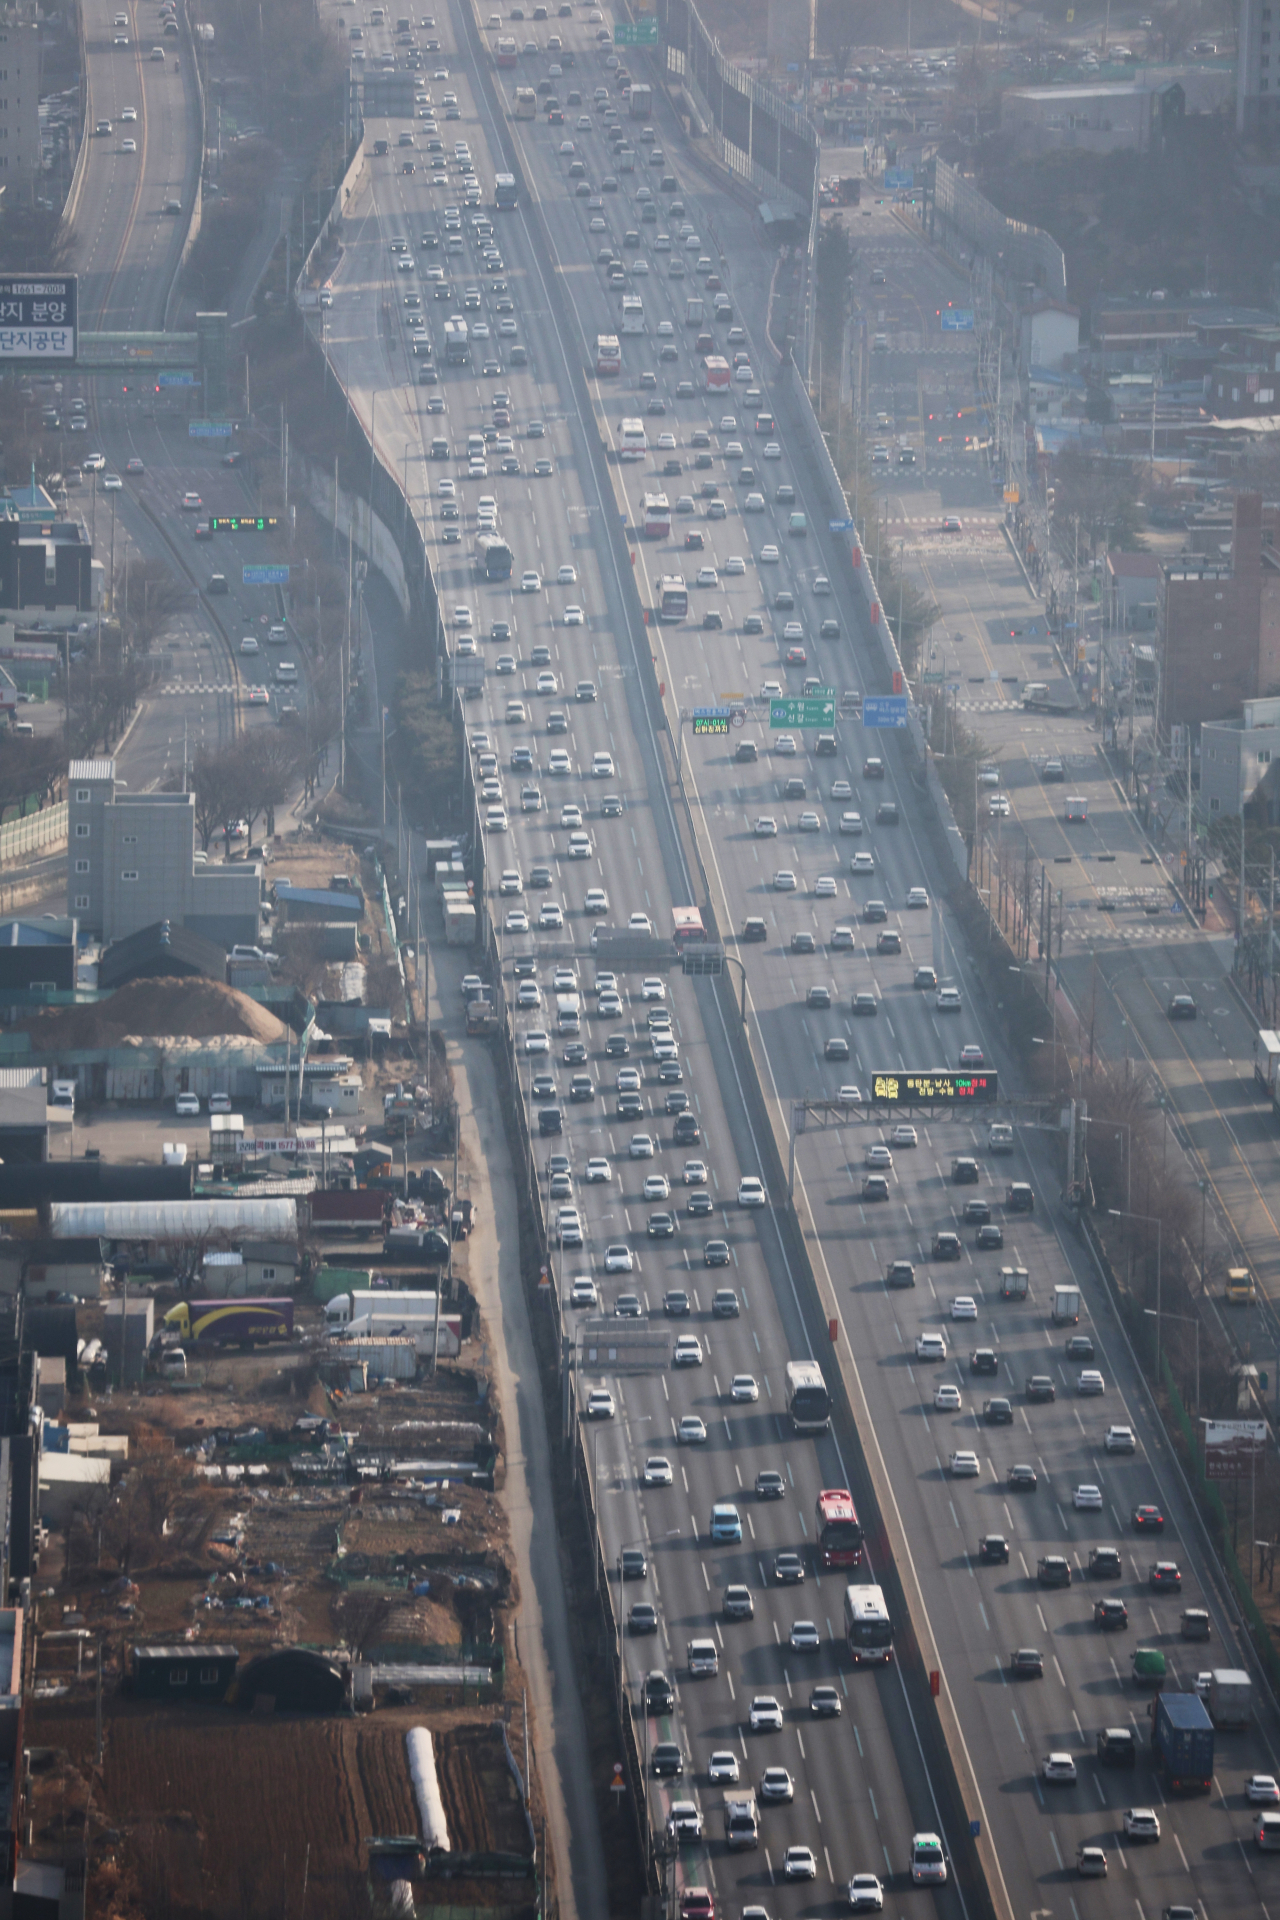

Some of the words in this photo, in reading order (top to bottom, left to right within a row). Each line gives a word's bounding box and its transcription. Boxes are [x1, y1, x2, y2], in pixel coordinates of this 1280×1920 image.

[15, 284, 65, 294] 1661-7005
[31, 301, 67, 322] 분양
[0, 331, 67, 351] 단지공단
[787, 702, 805, 712] 수원
